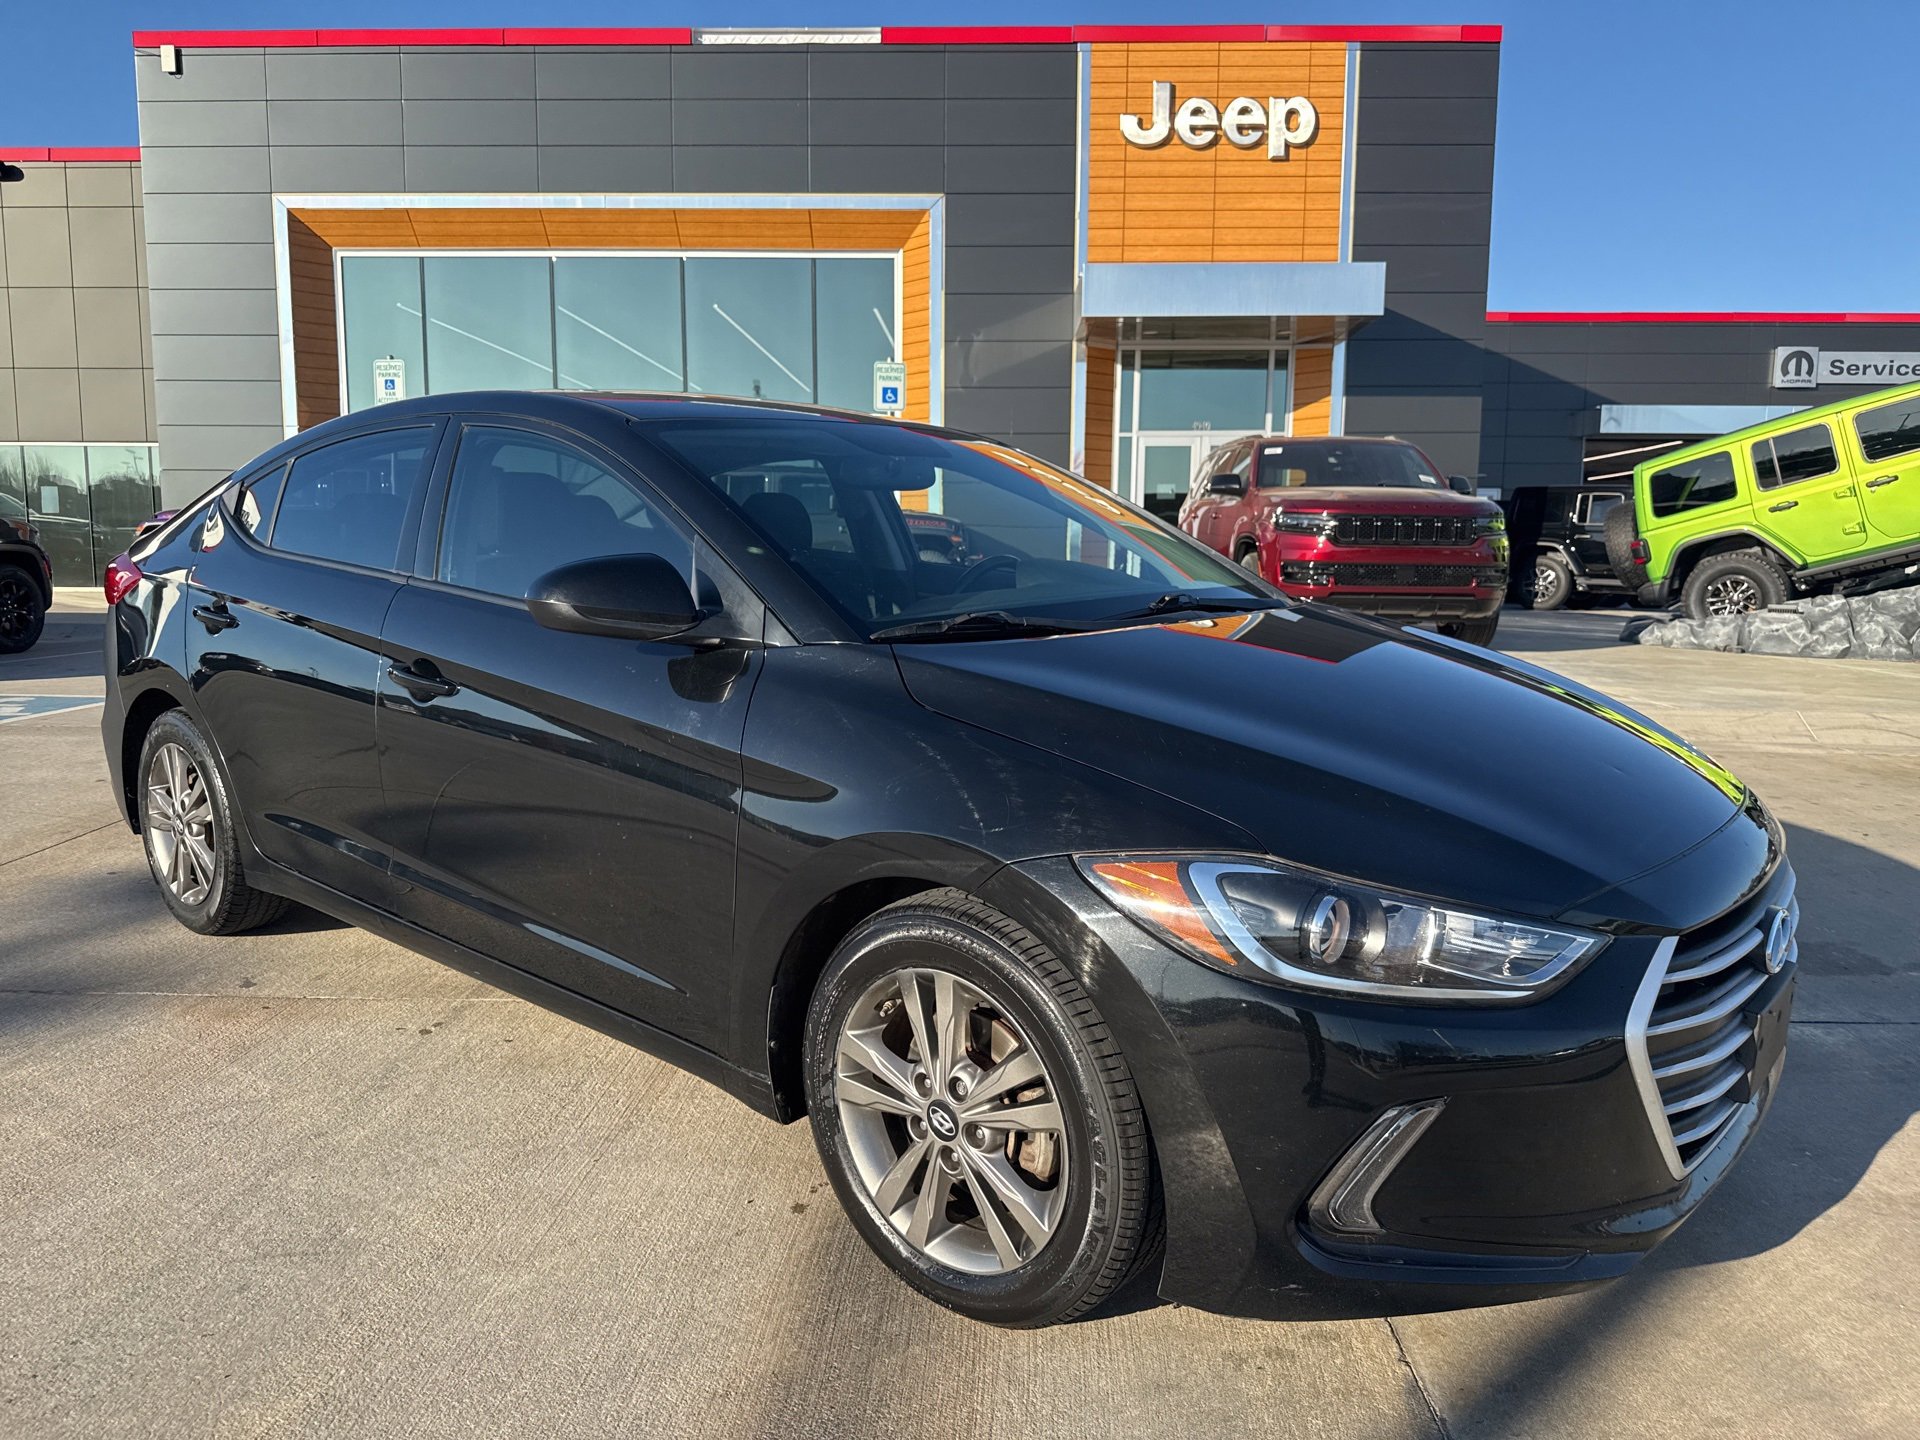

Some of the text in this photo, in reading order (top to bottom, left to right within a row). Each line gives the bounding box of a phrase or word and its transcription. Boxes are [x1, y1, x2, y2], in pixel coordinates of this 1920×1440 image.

[1119, 80, 1317, 160] Jeep
[877, 366, 903, 374] RESERVED
[1829, 359, 1920, 376] Service
